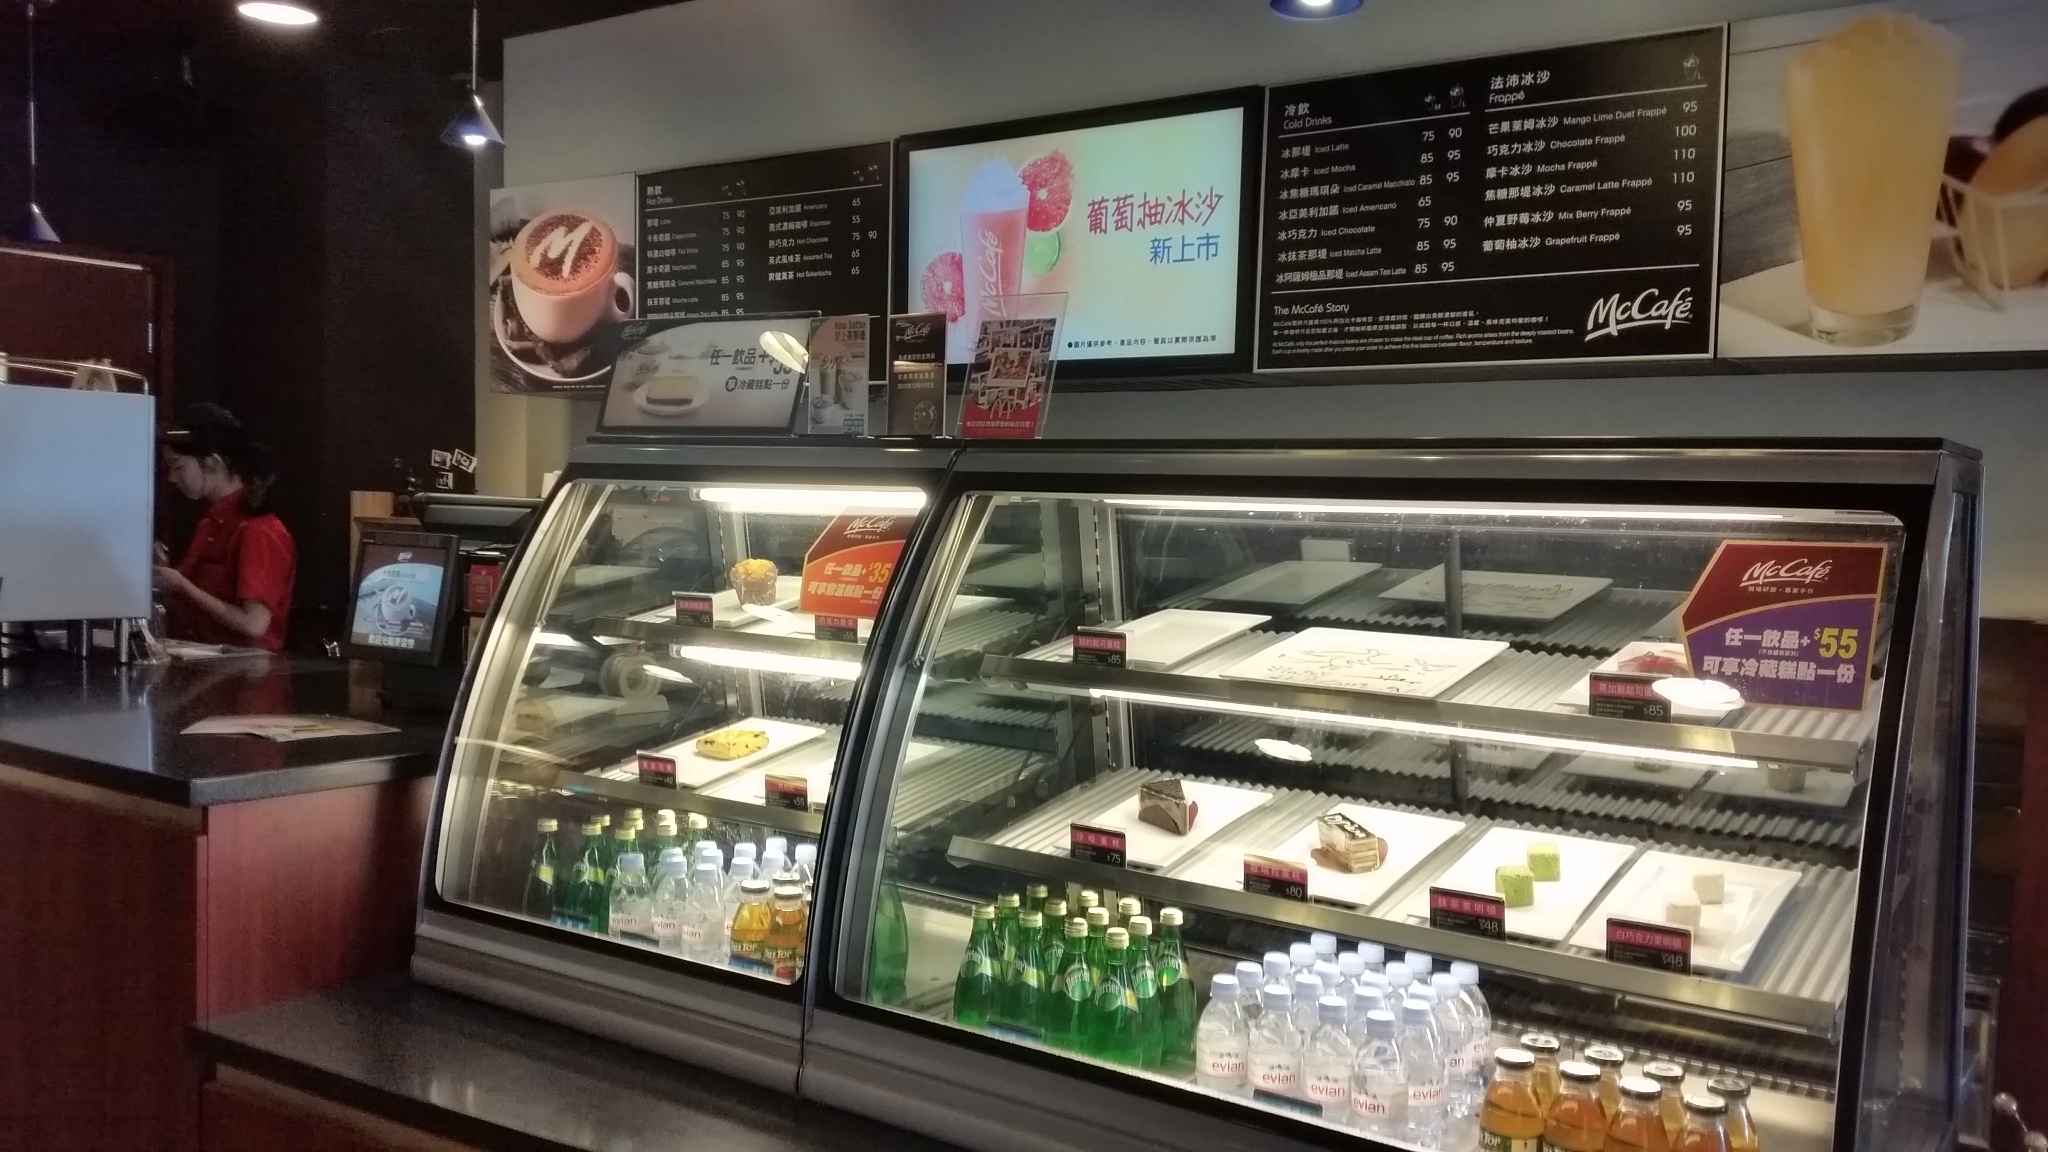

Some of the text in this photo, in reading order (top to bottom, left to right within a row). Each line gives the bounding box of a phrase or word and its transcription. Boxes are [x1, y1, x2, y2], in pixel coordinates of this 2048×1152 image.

[1490, 69, 1550, 90] 法沛冰沙
[1489, 91, 1525, 104] Frappé
[1284, 102, 1310, 117] 冷飲
[1283, 115, 1332, 130] Cold Drinks
[1488, 101, 1698, 135] 芒果萊姆冰沙 Mango Lime Duet Frappé 95
[1280, 128, 1462, 159] 冰那堤 Iced Latte 75 90
[1487, 125, 1697, 156] 巧克力冰沙 Chocolate Frappé 100
[1280, 150, 1461, 180] 冰摩卡 Iced Mocha 85 95
[1485, 147, 1696, 180] 摩卡冰沙 Mocha Frappé 110
[1343, 184, 1357, 193] Iced
[1358, 181, 1383, 192] Caramel
[1383, 178, 1416, 189] Macchiato
[1419, 174, 1433, 186] 85
[1446, 171, 1460, 182] 95
[1485, 171, 1695, 201] 焦糖那堤冰沙 Caramel Latte Frappé 110
[852, 198, 861, 207] 65
[1278, 196, 1432, 221] 冰亞美利加諾 Iced Americano 65
[721, 211, 730, 220] 75
[736, 210, 745, 218] 90
[852, 215, 861, 224] 55
[1483, 199, 1693, 228] 仲夏野莓冰沙 Mix Berry Frappé 95
[721, 227, 730, 236] 75
[736, 226, 745, 234] 90
[851, 232, 860, 241] 75
[868, 230, 878, 239] 90
[1277, 215, 1458, 242] 冰巧克力 Iced Chocolate 75 90
[1482, 224, 1692, 253] 葡萄柚冰沙 Grapefruit Frappé 95
[721, 244, 730, 252] 75
[736, 242, 745, 251] 90
[851, 249, 860, 258] 65
[1149, 232, 1220, 265] 新上市
[1277, 238, 1457, 263] 冰抹茶那堤 Iced Matcha Latte 85 95
[721, 260, 730, 269] 85
[736, 258, 745, 267] 95
[851, 266, 860, 275] 65
[1345, 270, 1359, 278] Iced
[1359, 269, 1379, 278] Assam
[1379, 267, 1391, 276] Tea
[1391, 266, 1407, 275] Latte
[1415, 263, 1428, 274] 85
[1441, 262, 1455, 272] 95
[721, 276, 730, 284] 85
[736, 274, 745, 283] 95
[721, 293, 730, 302] 85
[735, 292, 744, 301] 95
[1273, 302, 1350, 315] The McCafé Story
[1584, 287, 1694, 341] McCafé
[844, 515, 897, 535] McCafé
[868, 562, 893, 584] $35
[1739, 558, 1833, 587] McCafé
[1813, 626, 1859, 660] $55
[1107, 654, 1121, 665] $85
[1702, 655, 1856, 684] 可享冷藏糕點一份
[1643, 704, 1664, 717] $85
[1107, 852, 1121, 864] $75
[1285, 884, 1303, 898] $80
[611, 916, 637, 926] evian
[1480, 921, 1499, 933] $48
[1662, 953, 1683, 968] $48
[1212, 1061, 1244, 1073] evian
[1262, 1072, 1296, 1085] evian
[1311, 1083, 1345, 1098] evian
[1353, 1097, 1385, 1115] evian
